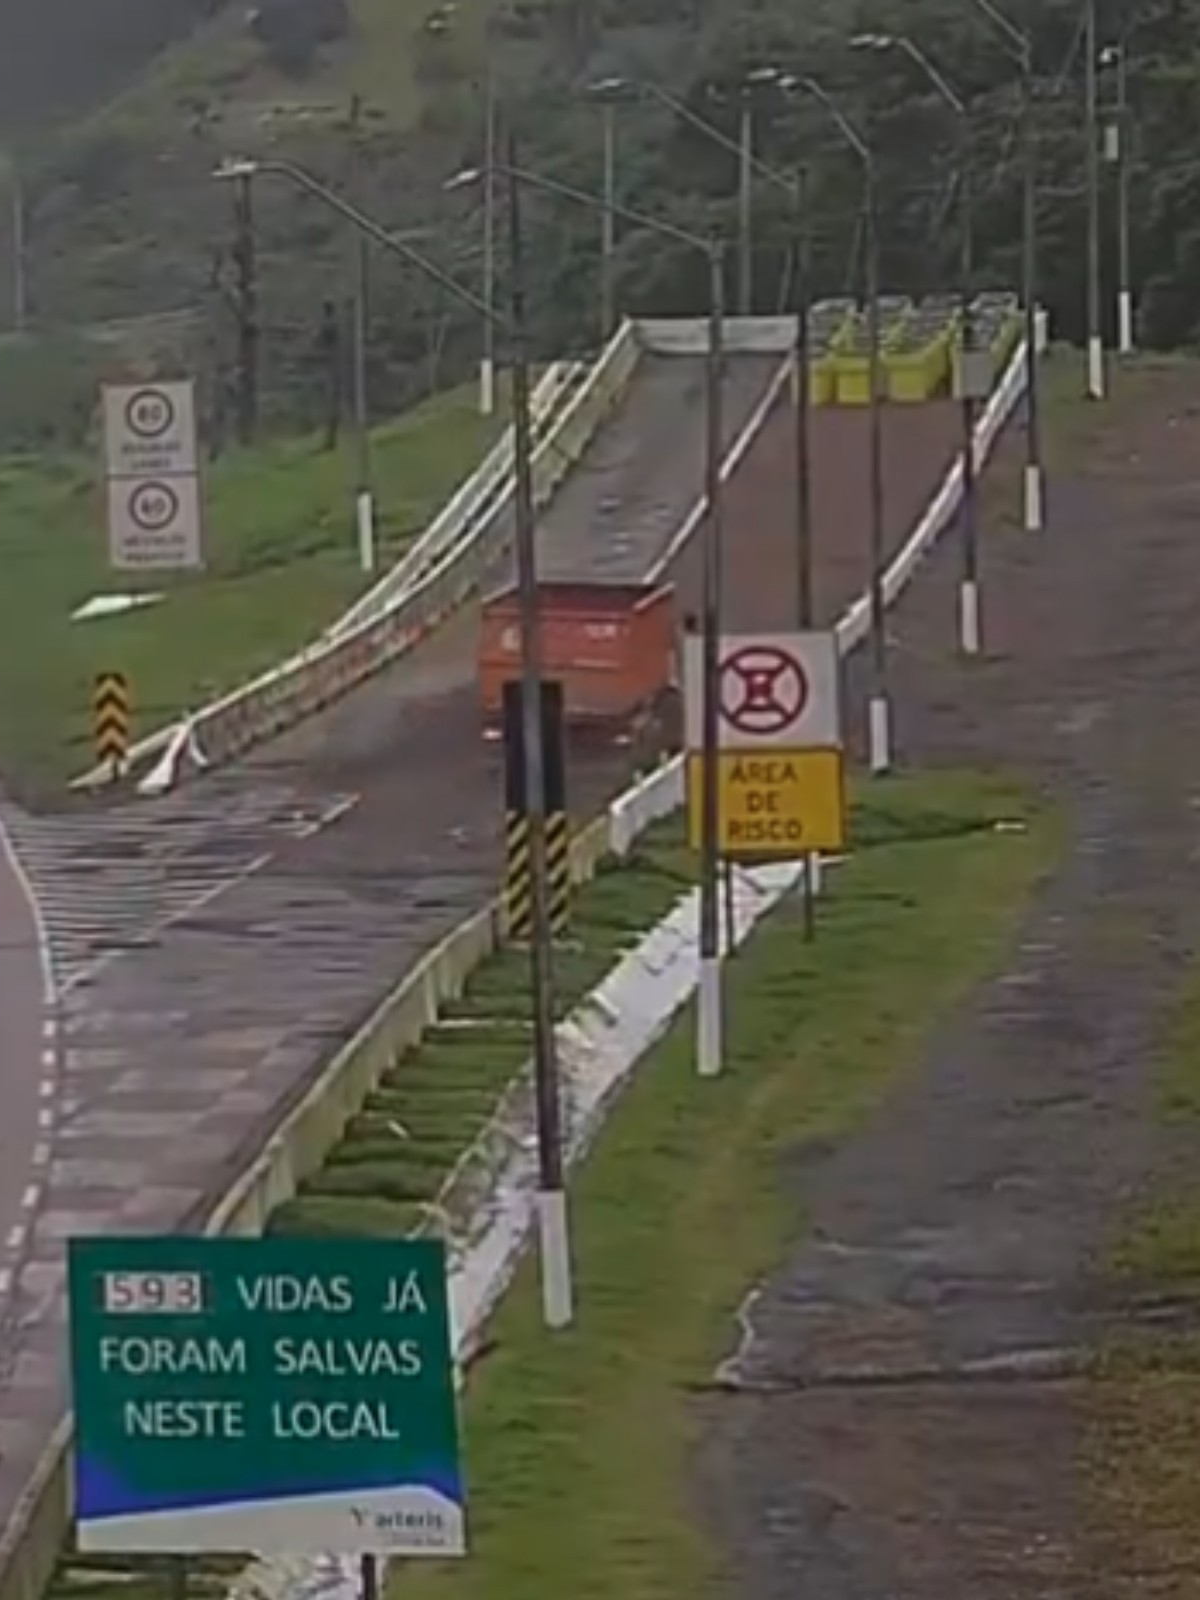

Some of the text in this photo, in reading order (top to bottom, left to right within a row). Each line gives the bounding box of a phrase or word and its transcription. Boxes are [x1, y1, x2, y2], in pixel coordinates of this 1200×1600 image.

[729, 757, 798, 783] ÁREA
[746, 790, 781, 813] DE
[728, 819, 803, 841] RISCO
[109, 1271, 426, 1313] 593 VIDAS JÁ
[100, 1339, 422, 1375] FORAM SALVAS
[124, 1402, 400, 1438] NESTE LOCAL
[374, 1511, 445, 1528] arteris
